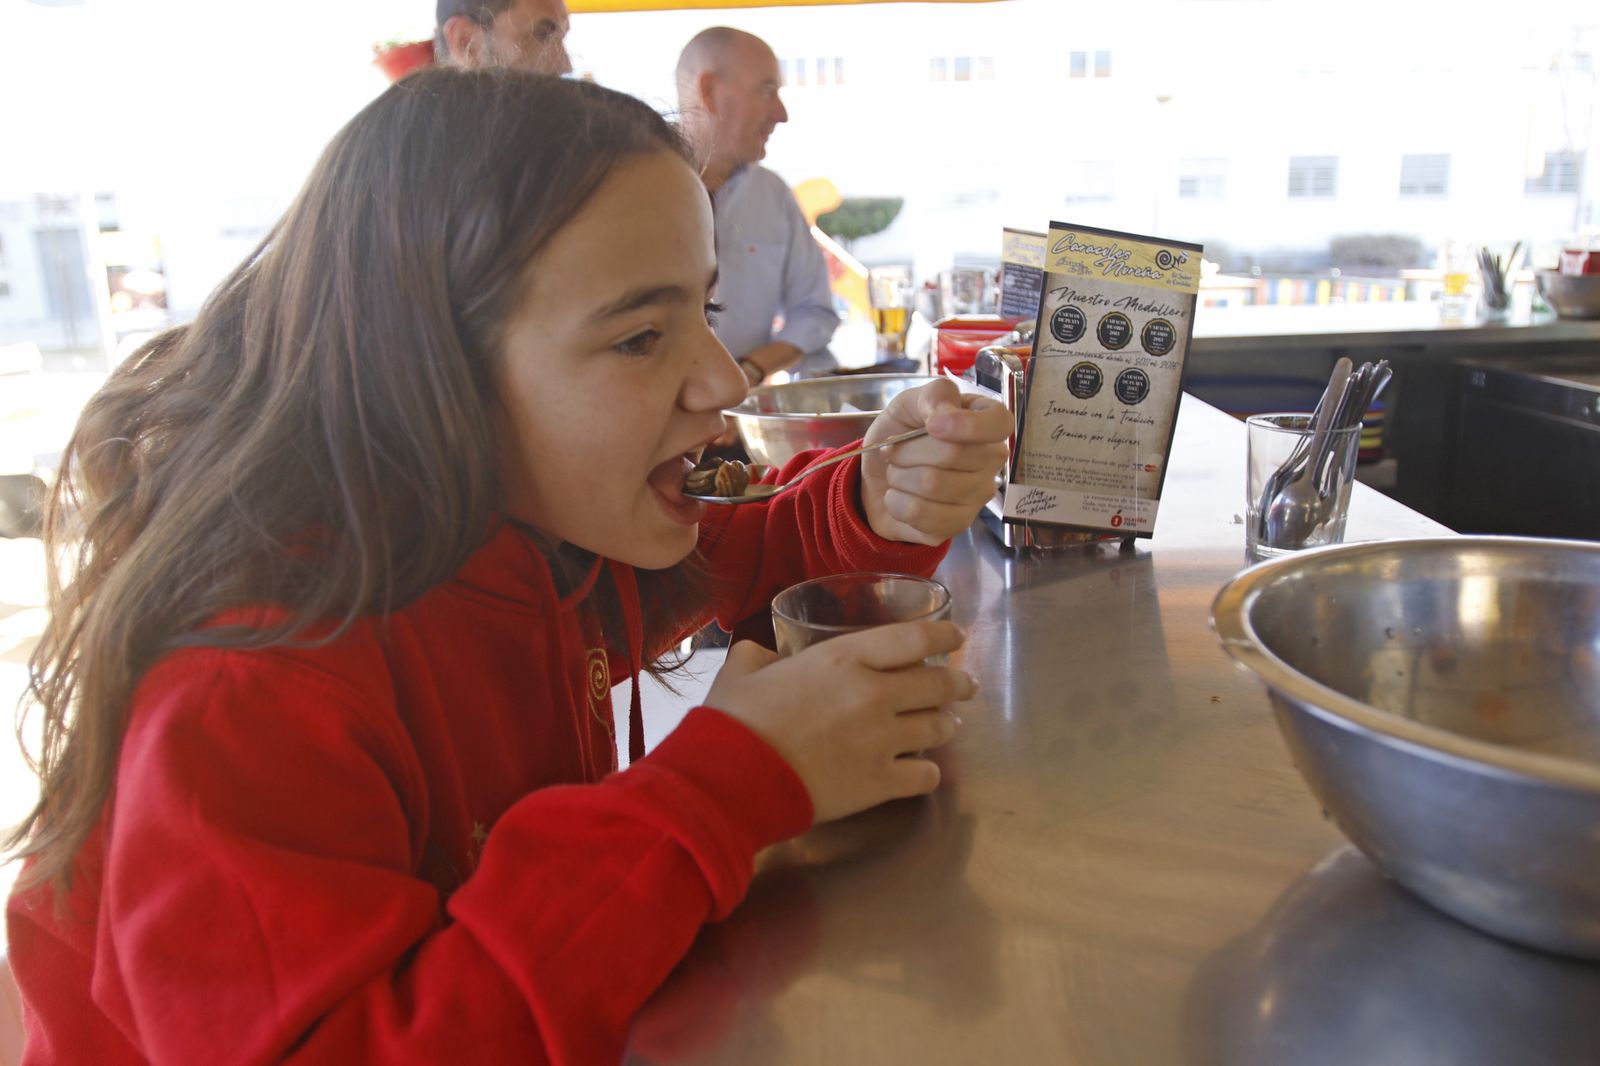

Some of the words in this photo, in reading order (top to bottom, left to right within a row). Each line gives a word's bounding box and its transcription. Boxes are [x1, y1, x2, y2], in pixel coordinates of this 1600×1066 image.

[1052, 233, 1132, 261] Caracoles
[1095, 256, 1163, 280] Noreña
[1050, 286, 1110, 307] Nuestro
[1113, 296, 1187, 317] Medallero
[1044, 400, 1088, 417] Innovando
[1090, 411, 1103, 419] con
[1106, 408, 1116, 420] la
[1120, 410, 1155, 426] Tradición
[1051, 424, 1087, 441] Gracias
[1089, 433, 1104, 445] por
[1107, 434, 1140, 450] elegirnos
[1015, 495, 1057, 509] Caracoles
[1027, 488, 1045, 500] Hay
[1028, 503, 1058, 517] gluten
